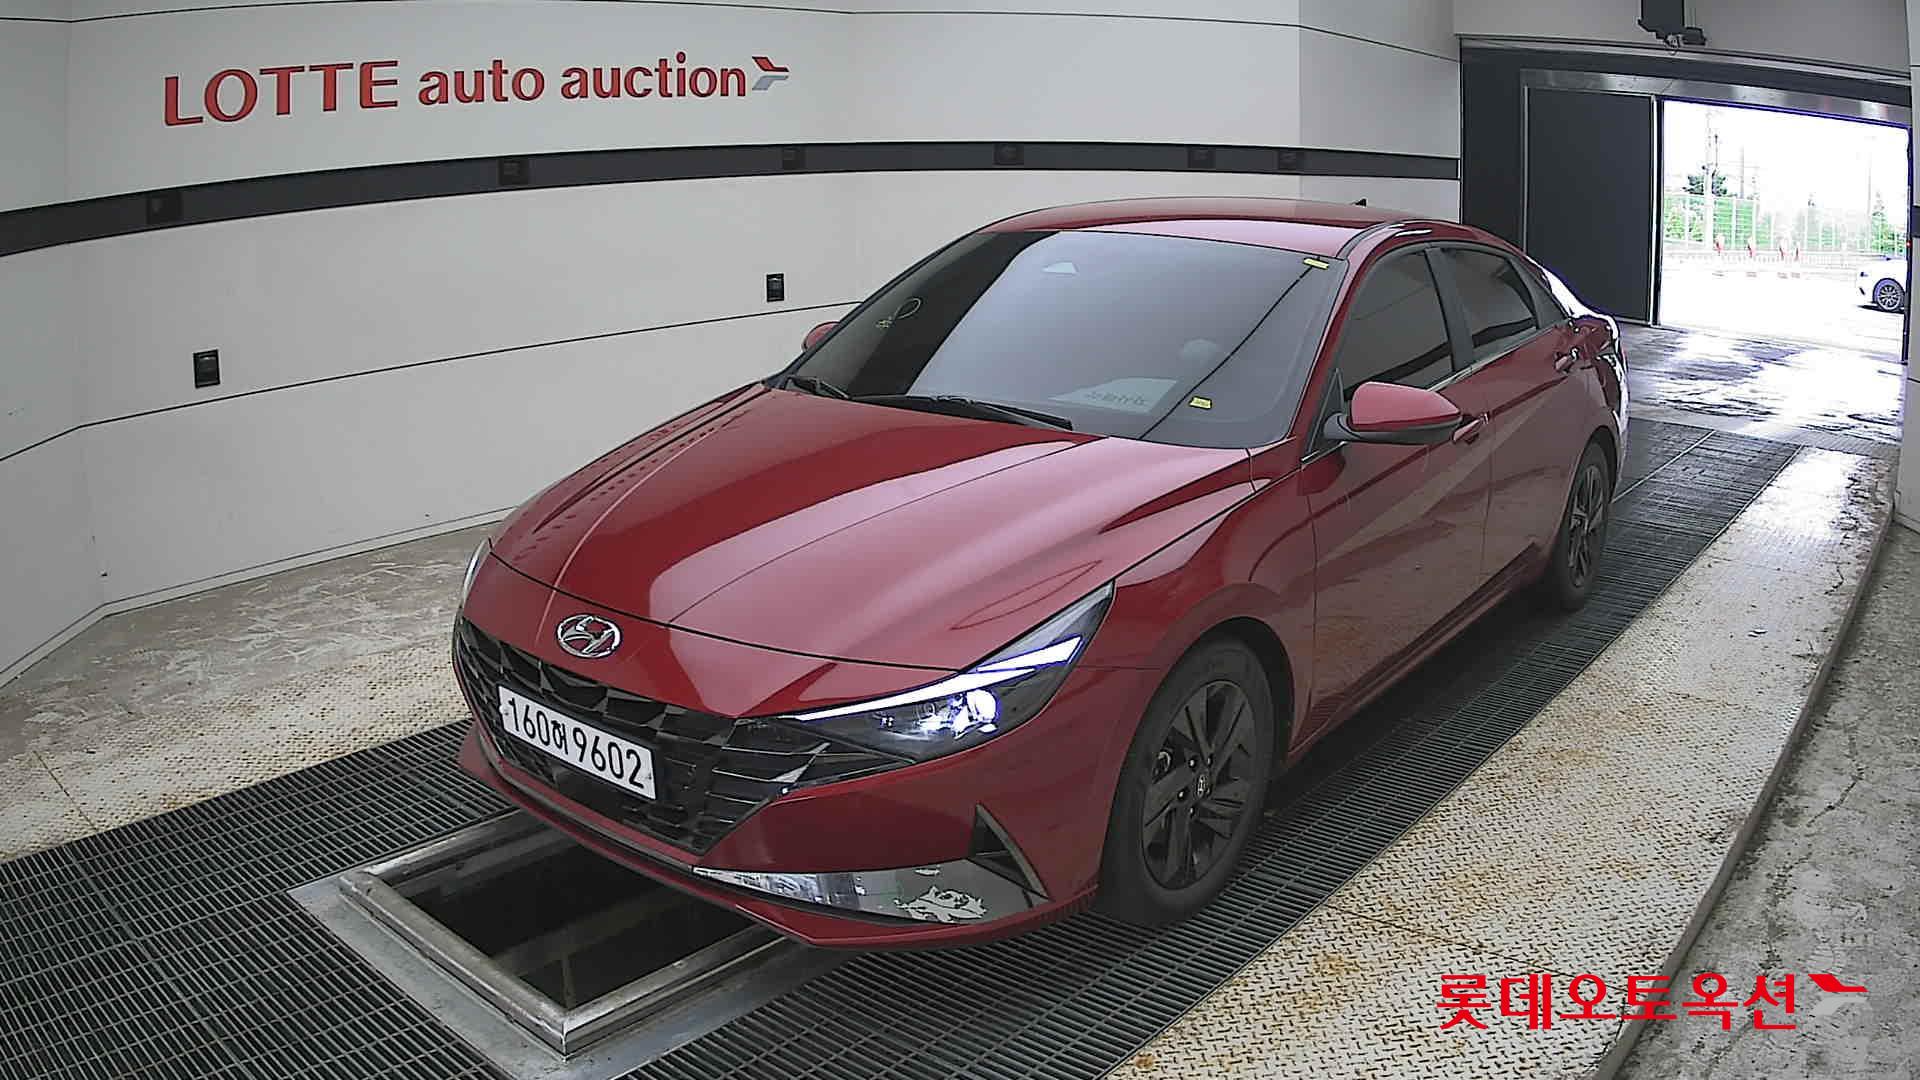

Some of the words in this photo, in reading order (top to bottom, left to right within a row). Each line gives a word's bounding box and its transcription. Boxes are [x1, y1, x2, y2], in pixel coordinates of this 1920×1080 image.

[163, 60, 399, 127] LOTTE
[418, 59, 546, 106] auto
[561, 51, 748, 99] auction
[572, 727, 645, 789] 9602
